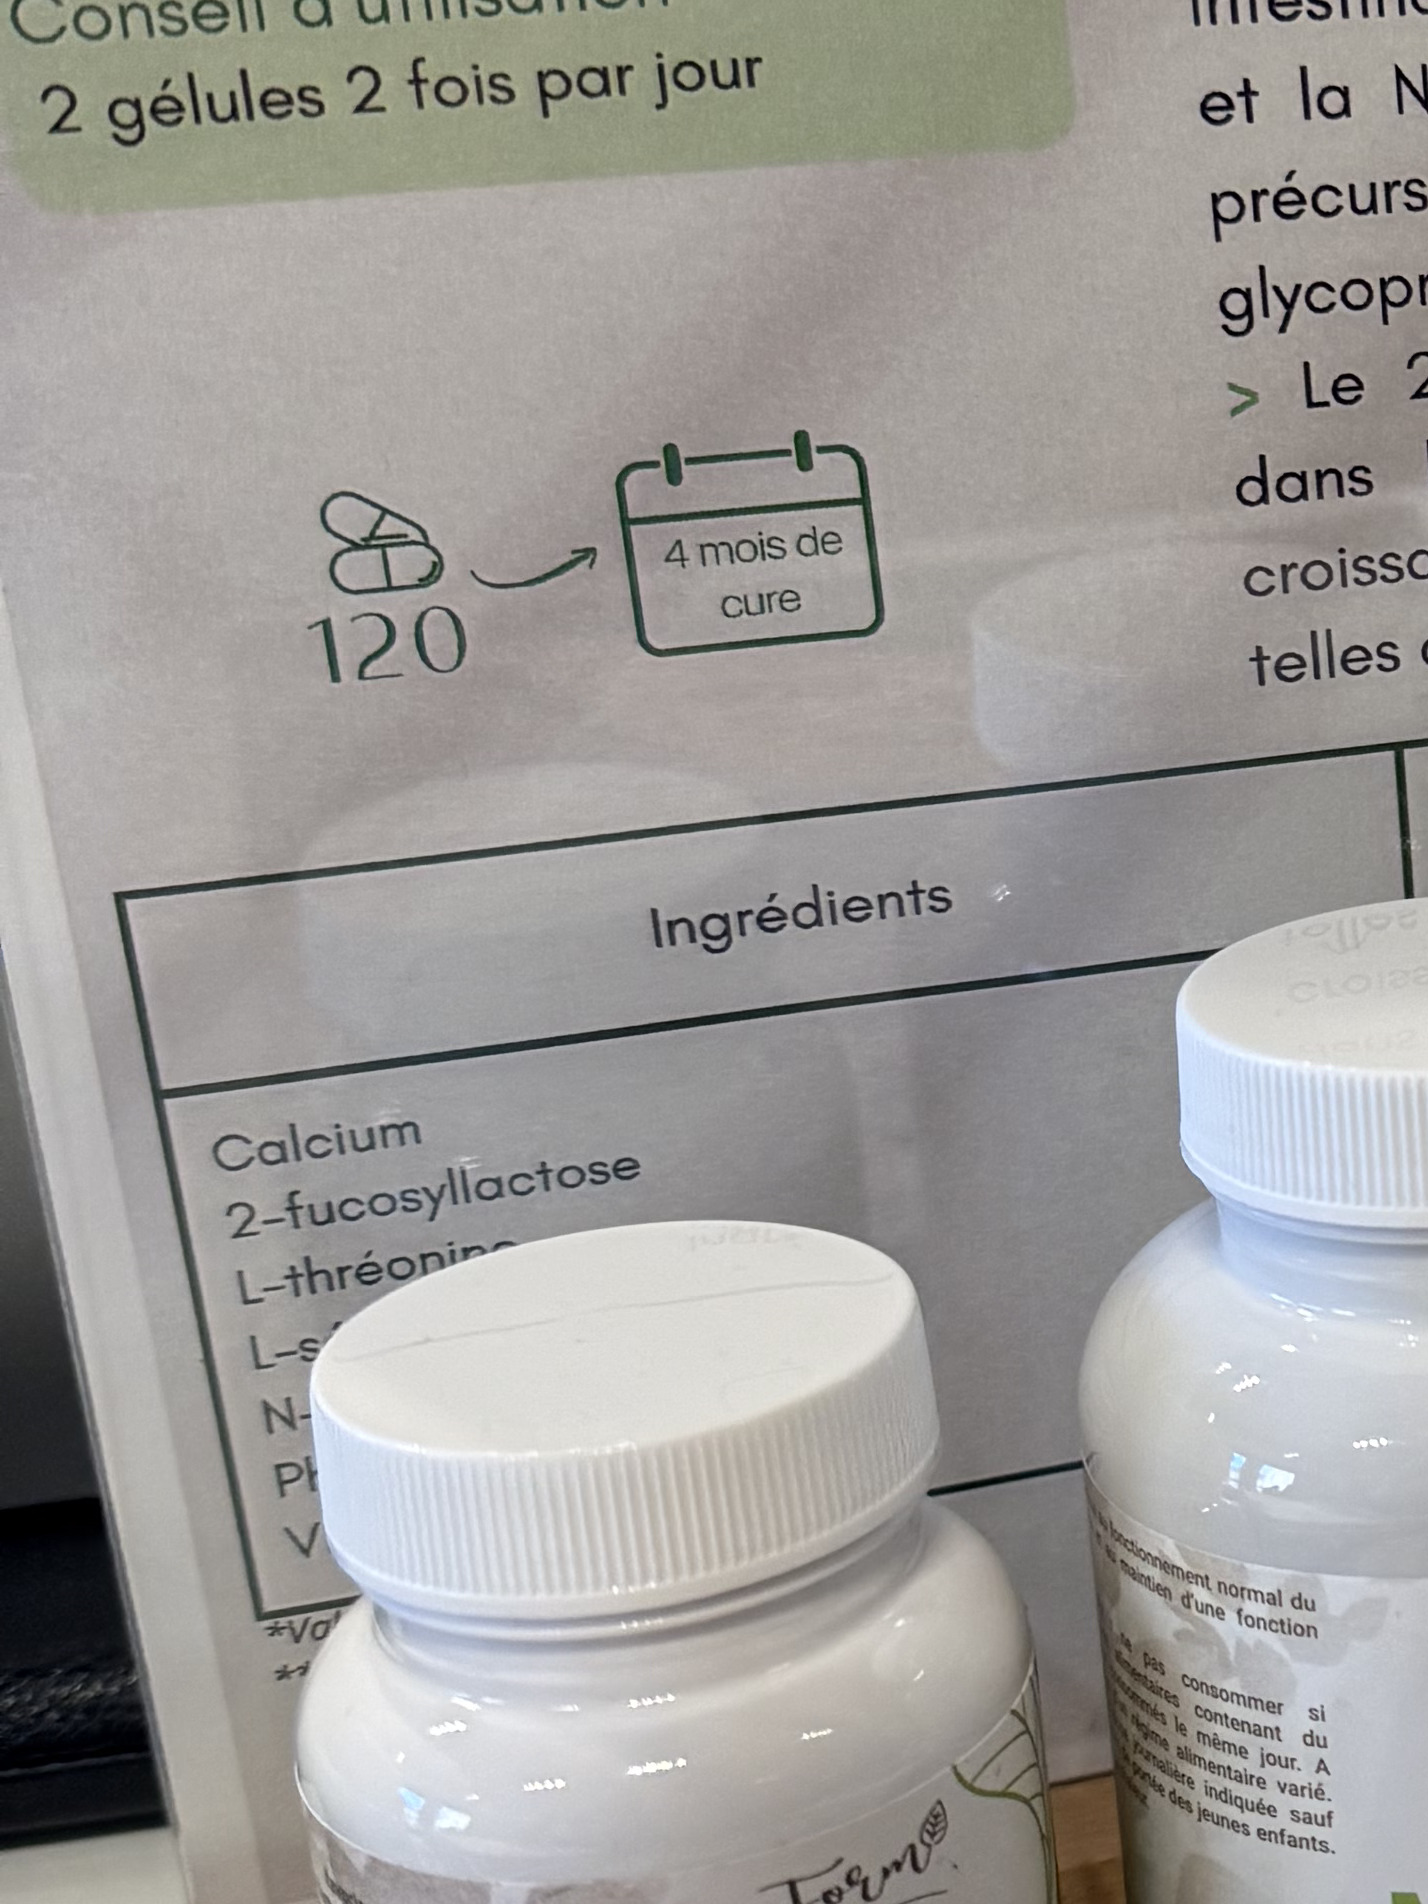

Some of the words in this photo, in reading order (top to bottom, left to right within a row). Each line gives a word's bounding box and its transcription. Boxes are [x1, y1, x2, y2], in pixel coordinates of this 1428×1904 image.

[41, 84, 82, 134] 2
[108, 68, 325, 147] gélules
[346, 65, 386, 114] 2
[407, 56, 516, 109] fois
[537, 65, 634, 118] par
[655, 52, 762, 111] jour
[664, 539, 689, 569] 4
[698, 531, 787, 567] mois
[795, 526, 842, 557] de
[720, 589, 801, 619] cure
[307, 606, 466, 683] 120
[1249, 628, 1400, 686] telles
[650, 880, 952, 954] Ingrédients
[213, 1120, 422, 1173] Calcium
[225, 1151, 641, 1242] 2-fucosyllactose
[1181, 1671, 1284, 1718] consommer
[1308, 1704, 1327, 1723] si
